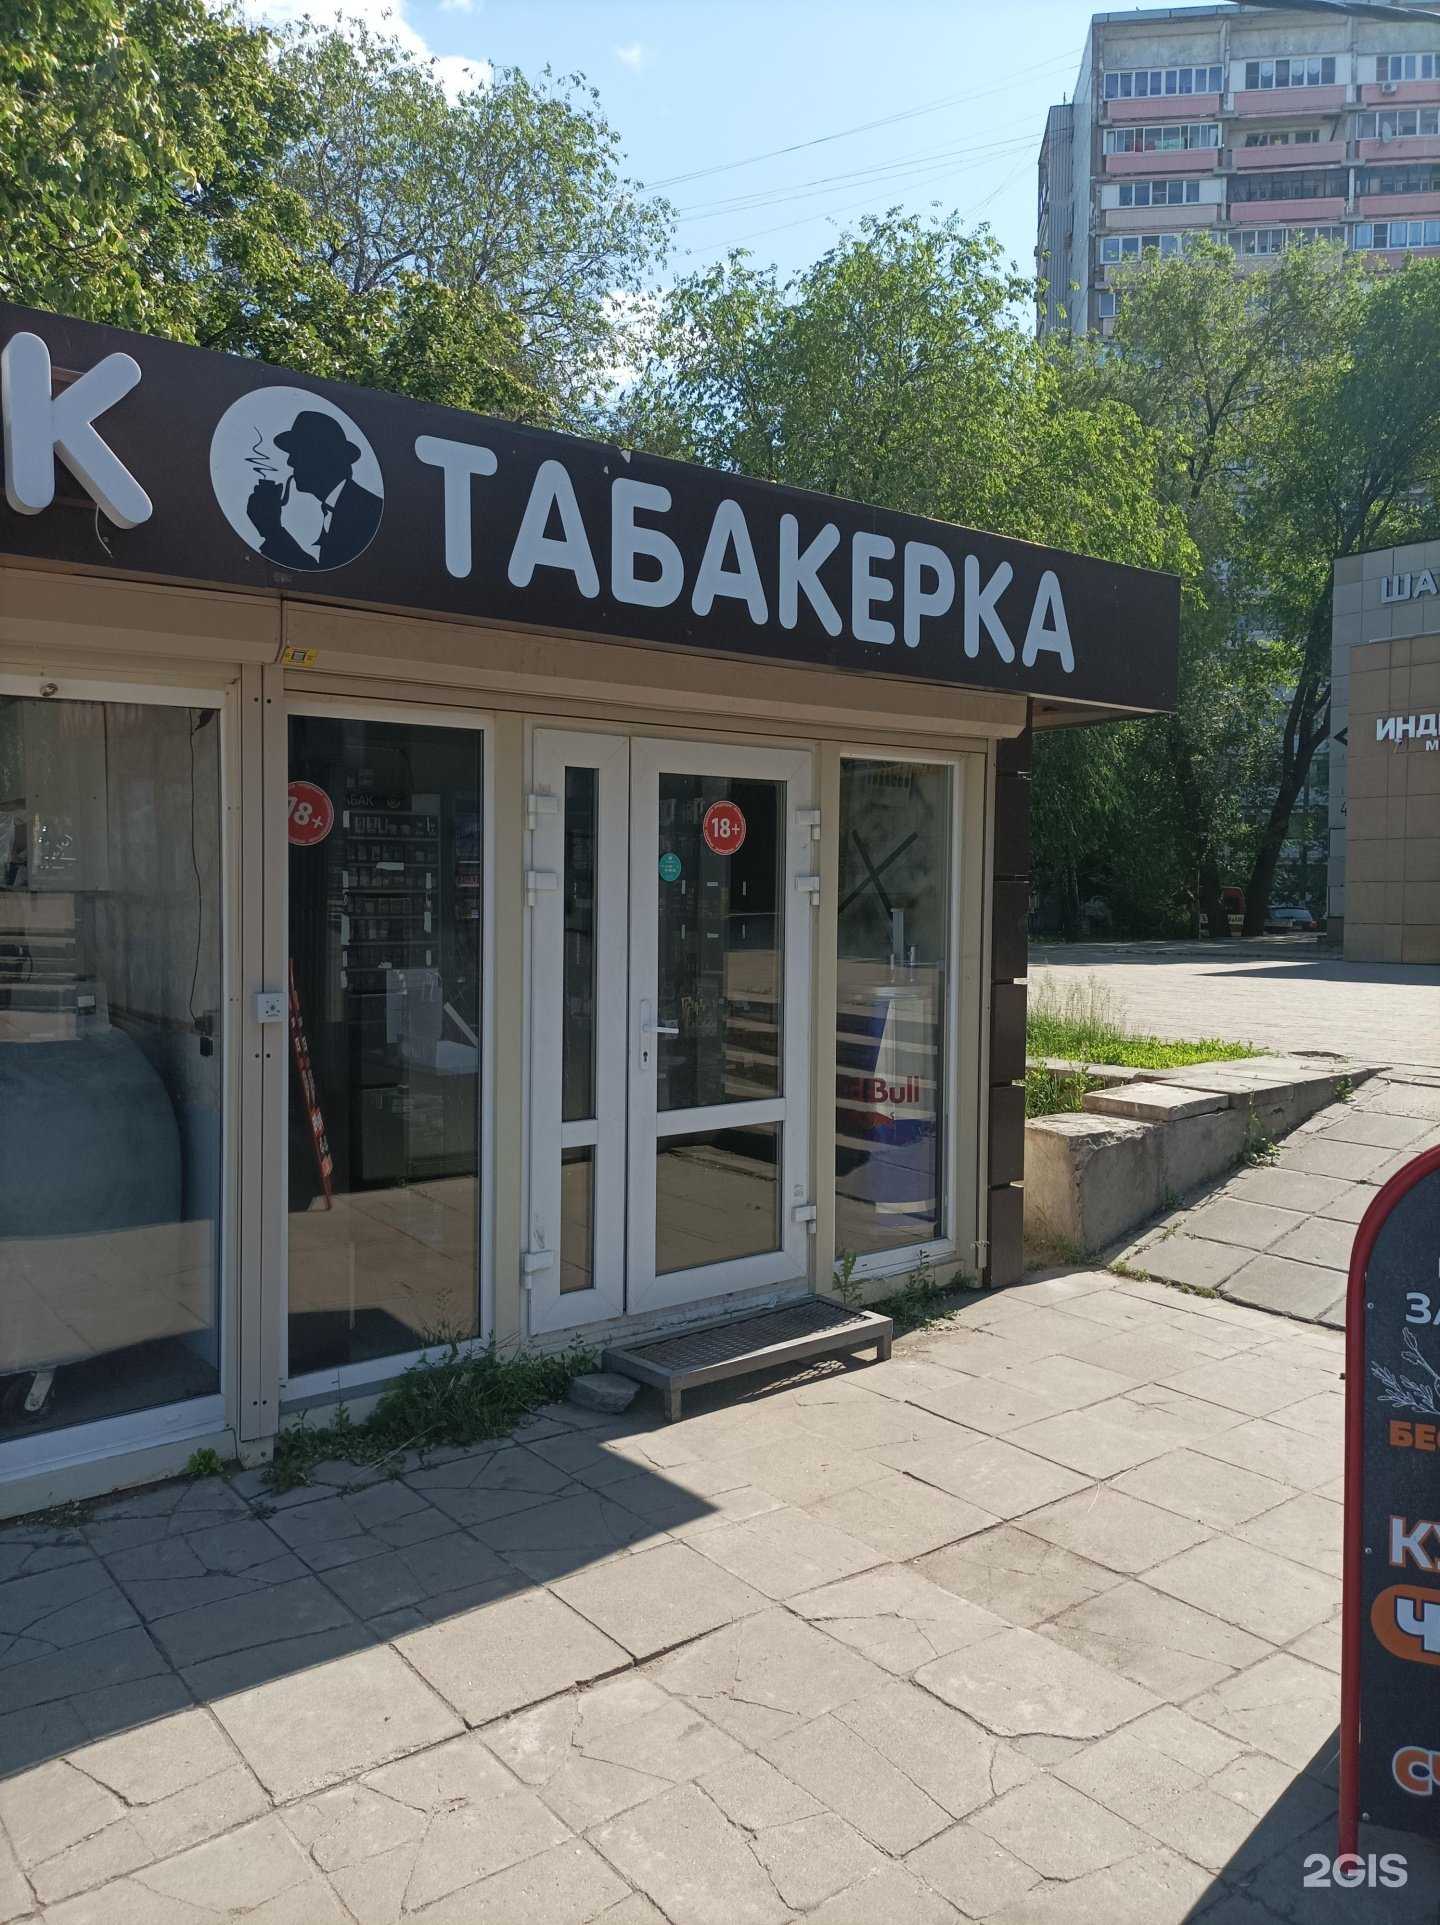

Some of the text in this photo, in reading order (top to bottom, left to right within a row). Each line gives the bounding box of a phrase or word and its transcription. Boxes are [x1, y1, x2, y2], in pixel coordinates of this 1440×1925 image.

[1, 331, 153, 529] К
[414, 434, 1076, 673] ТАБАКЕРКА
[1380, 569, 1438, 604] ША
[1376, 713, 1440, 742] ИНД
[711, 816, 740, 838] 18+
[870, 1074, 921, 1104] Bull
[1389, 1420, 1440, 1452] БЕ
